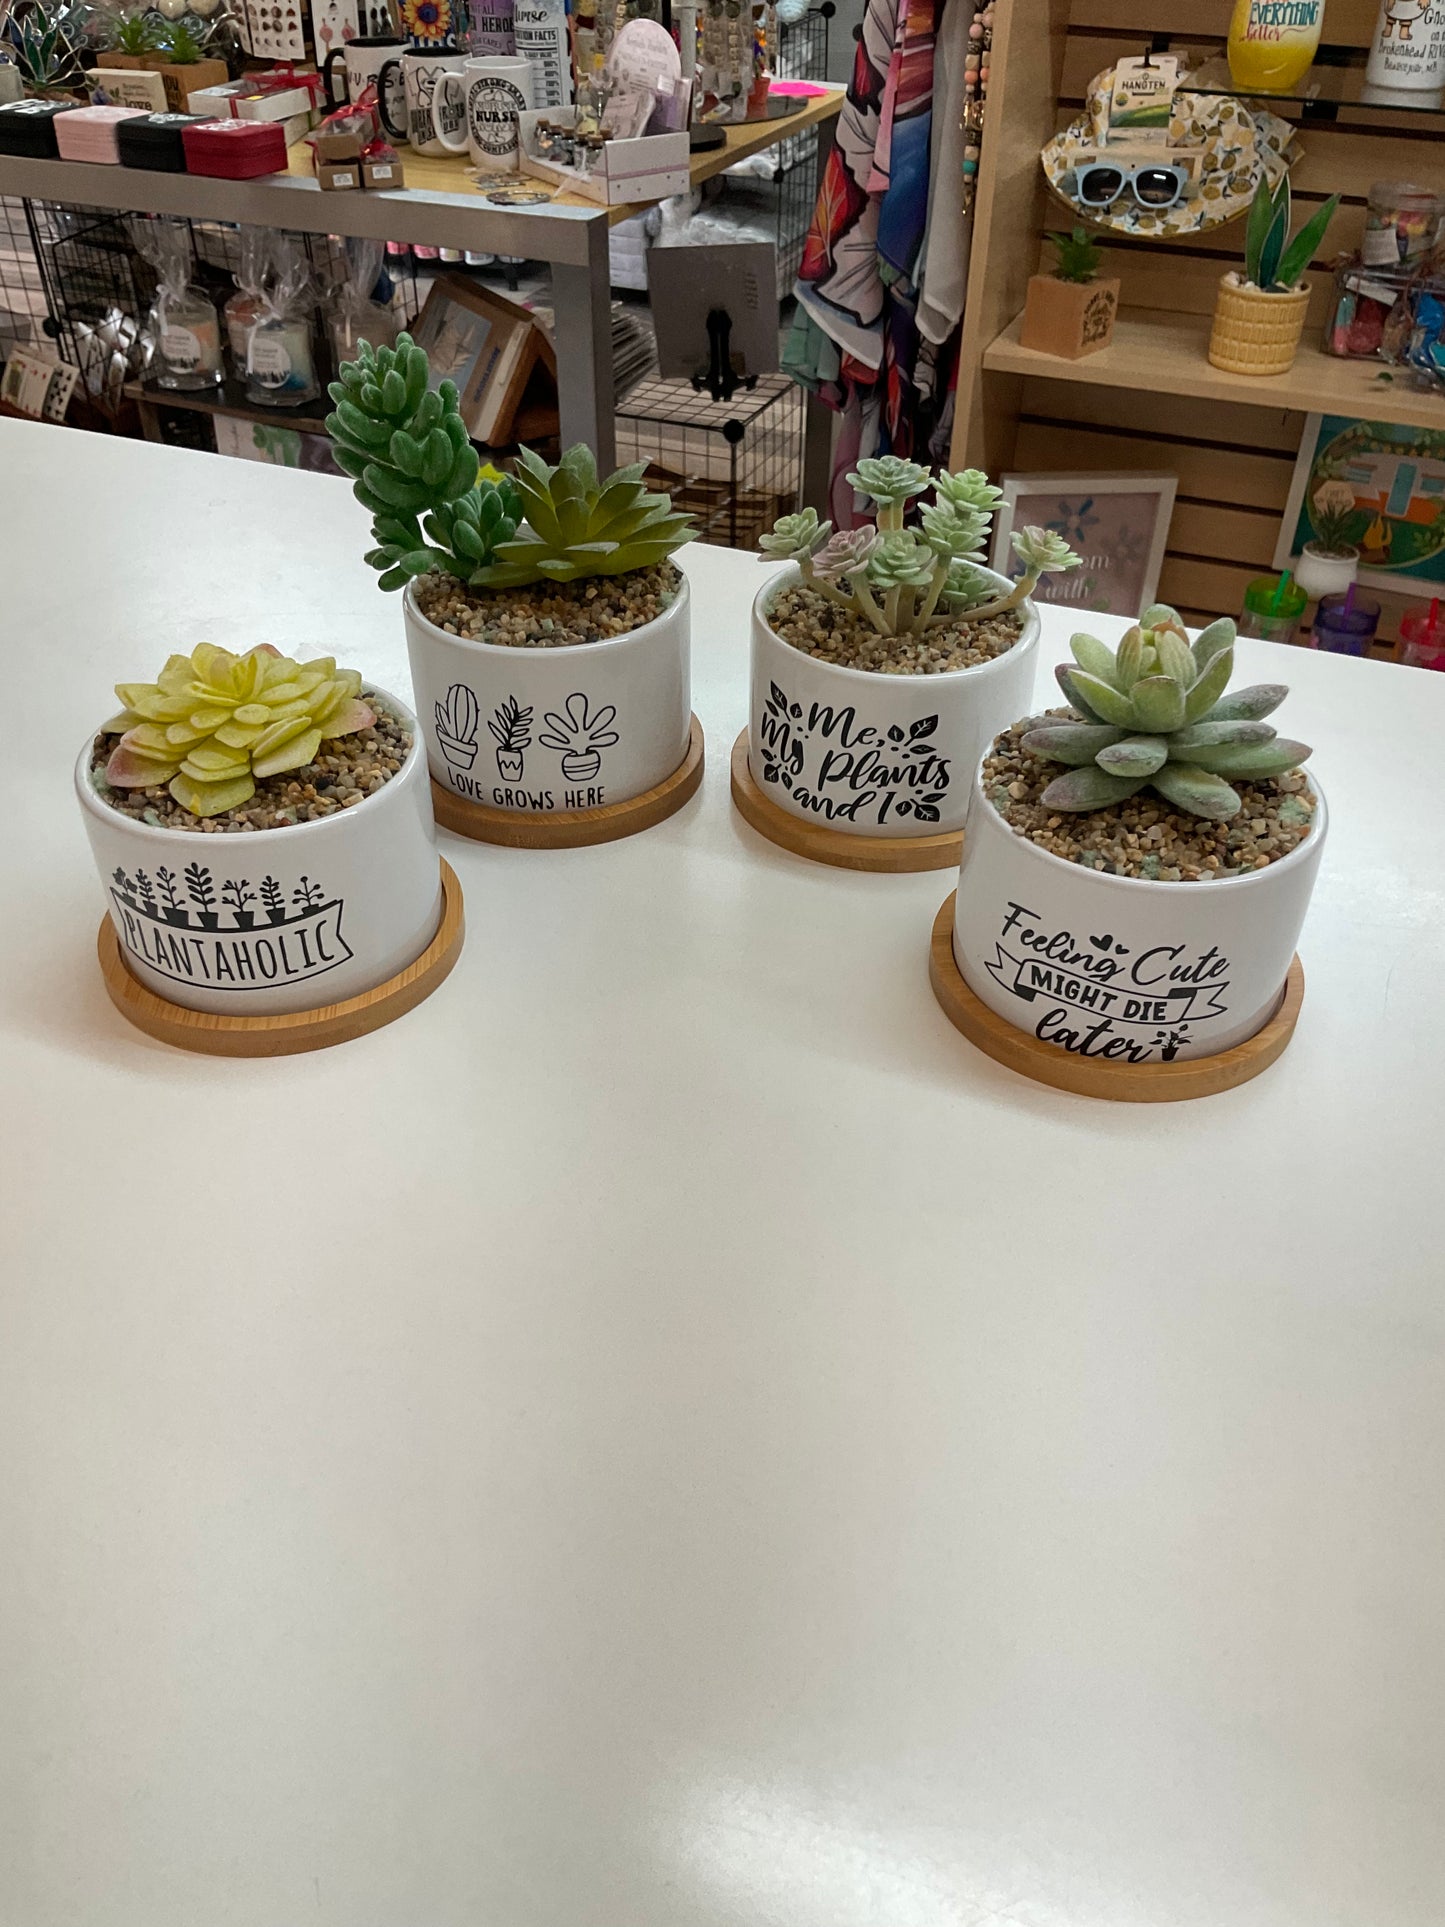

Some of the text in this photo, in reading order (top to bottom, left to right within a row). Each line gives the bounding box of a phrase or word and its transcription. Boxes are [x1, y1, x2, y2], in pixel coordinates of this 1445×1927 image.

[482, 16, 514, 33] HEROE
[1250, 2, 1319, 26] EVERYTHING
[1424, 8, 1445, 25] Gno
[534, 29, 556, 41] FACTS
[1428, 44, 1445, 59] RIVE
[475, 110, 517, 123] NURSE
[807, 702, 886, 749] Me,
[761, 712, 952, 792] My Plants
[448, 767, 605, 810] LOVE GROWS HERE
[792, 787, 898, 825] and I
[124, 909, 335, 981] PLANTAHOLIC
[1001, 901, 1231, 986] Feeling Cute
[1031, 964, 1168, 1021] MIGHT DIE
[1035, 1008, 1155, 1063] later
